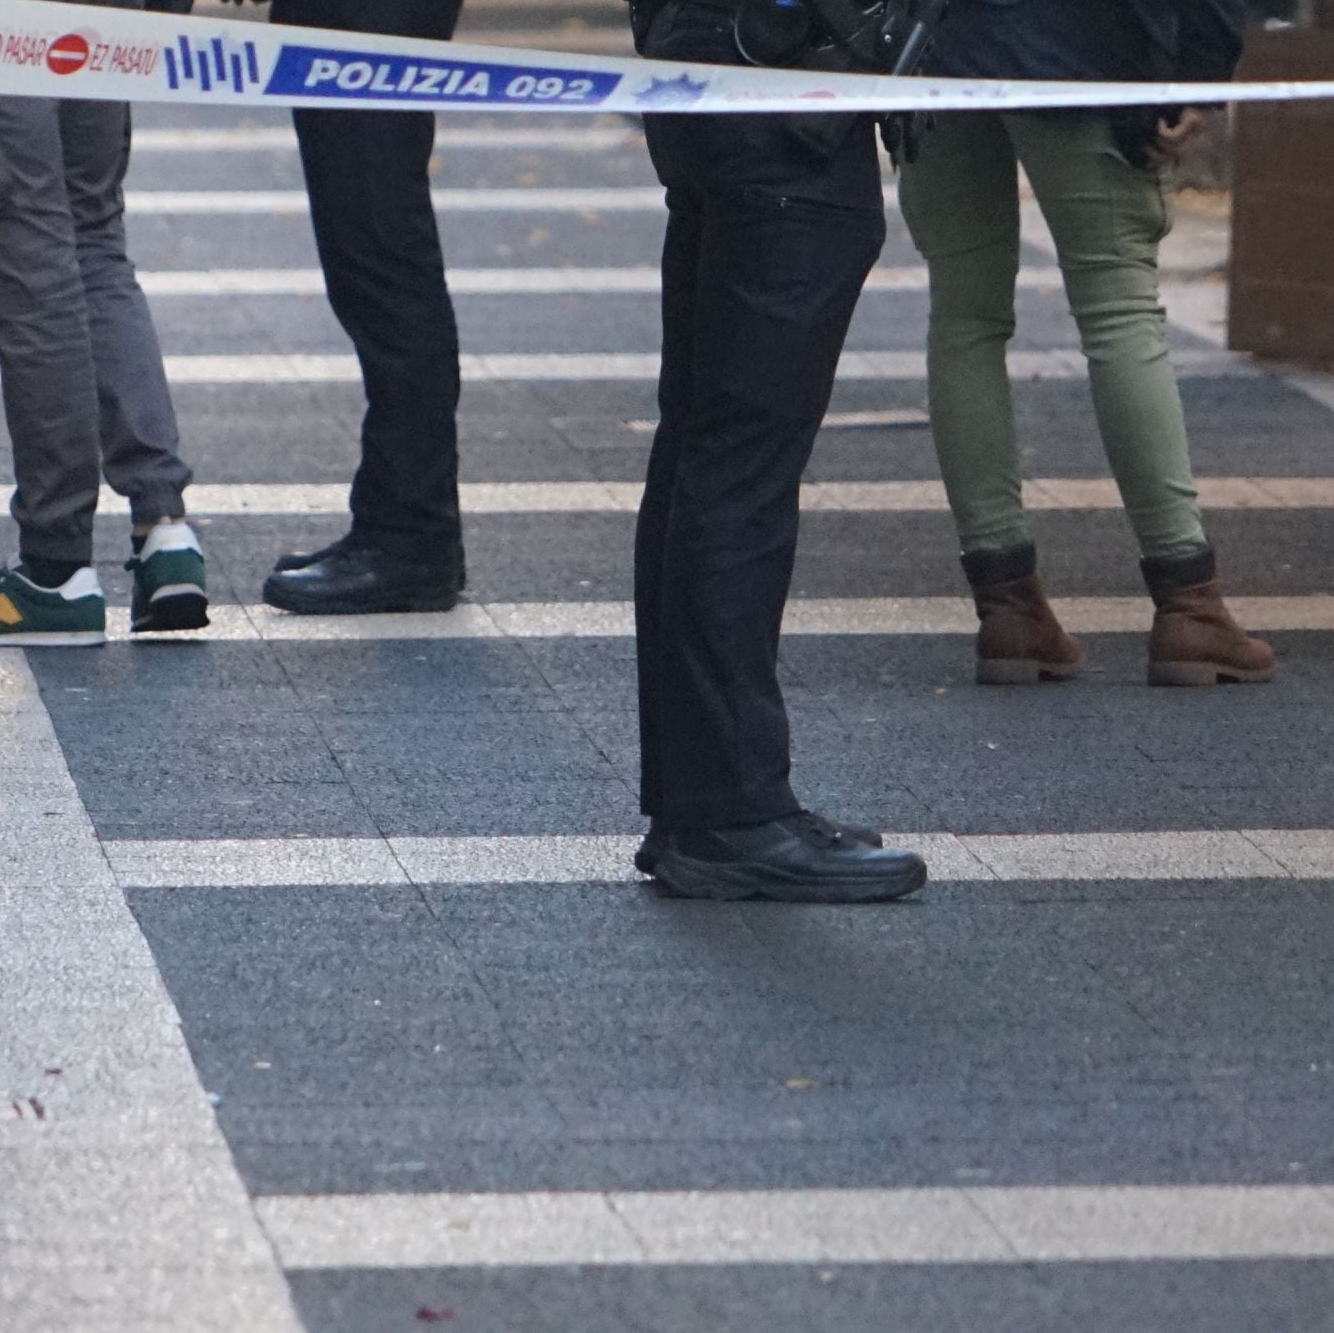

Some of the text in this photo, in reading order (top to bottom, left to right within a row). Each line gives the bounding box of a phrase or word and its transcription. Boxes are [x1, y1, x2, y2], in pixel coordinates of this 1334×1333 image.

[5, 33, 47, 67] PASAR
[88, 43, 109, 72] EZ
[110, 46, 159, 76] PASATU
[304, 58, 595, 100] POLIZIA 092
